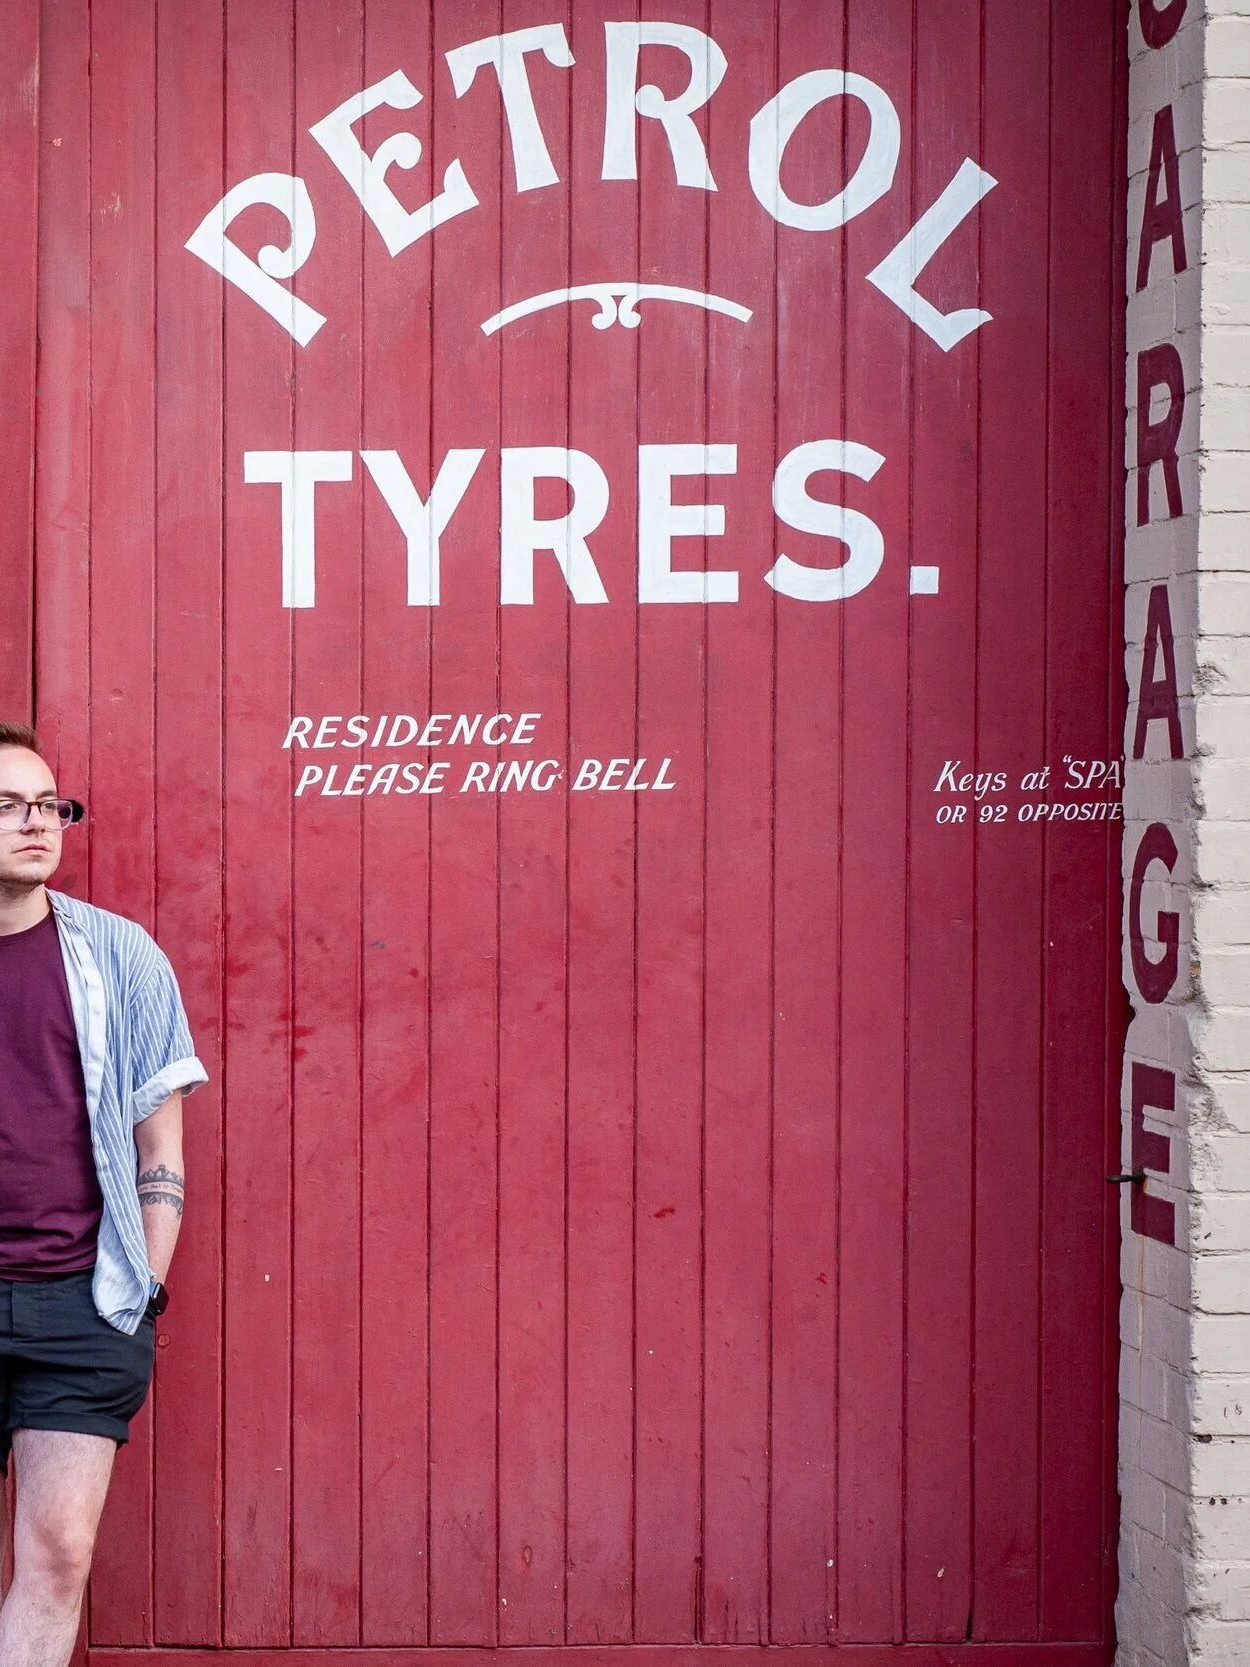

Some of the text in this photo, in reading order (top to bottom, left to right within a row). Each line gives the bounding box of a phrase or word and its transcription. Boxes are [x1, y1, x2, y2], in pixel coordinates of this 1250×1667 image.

[184, 21, 1000, 354] PETROL
[243, 439, 941, 609] TYRES.
[282, 713, 543, 750] RESIDENCE
[294, 758, 678, 798] PLEASE RING BELL
[933, 760, 1008, 802] Keys
[1020, 766, 1051, 791] at
[935, 802, 1124, 825] OR 92 OPPOSITE
